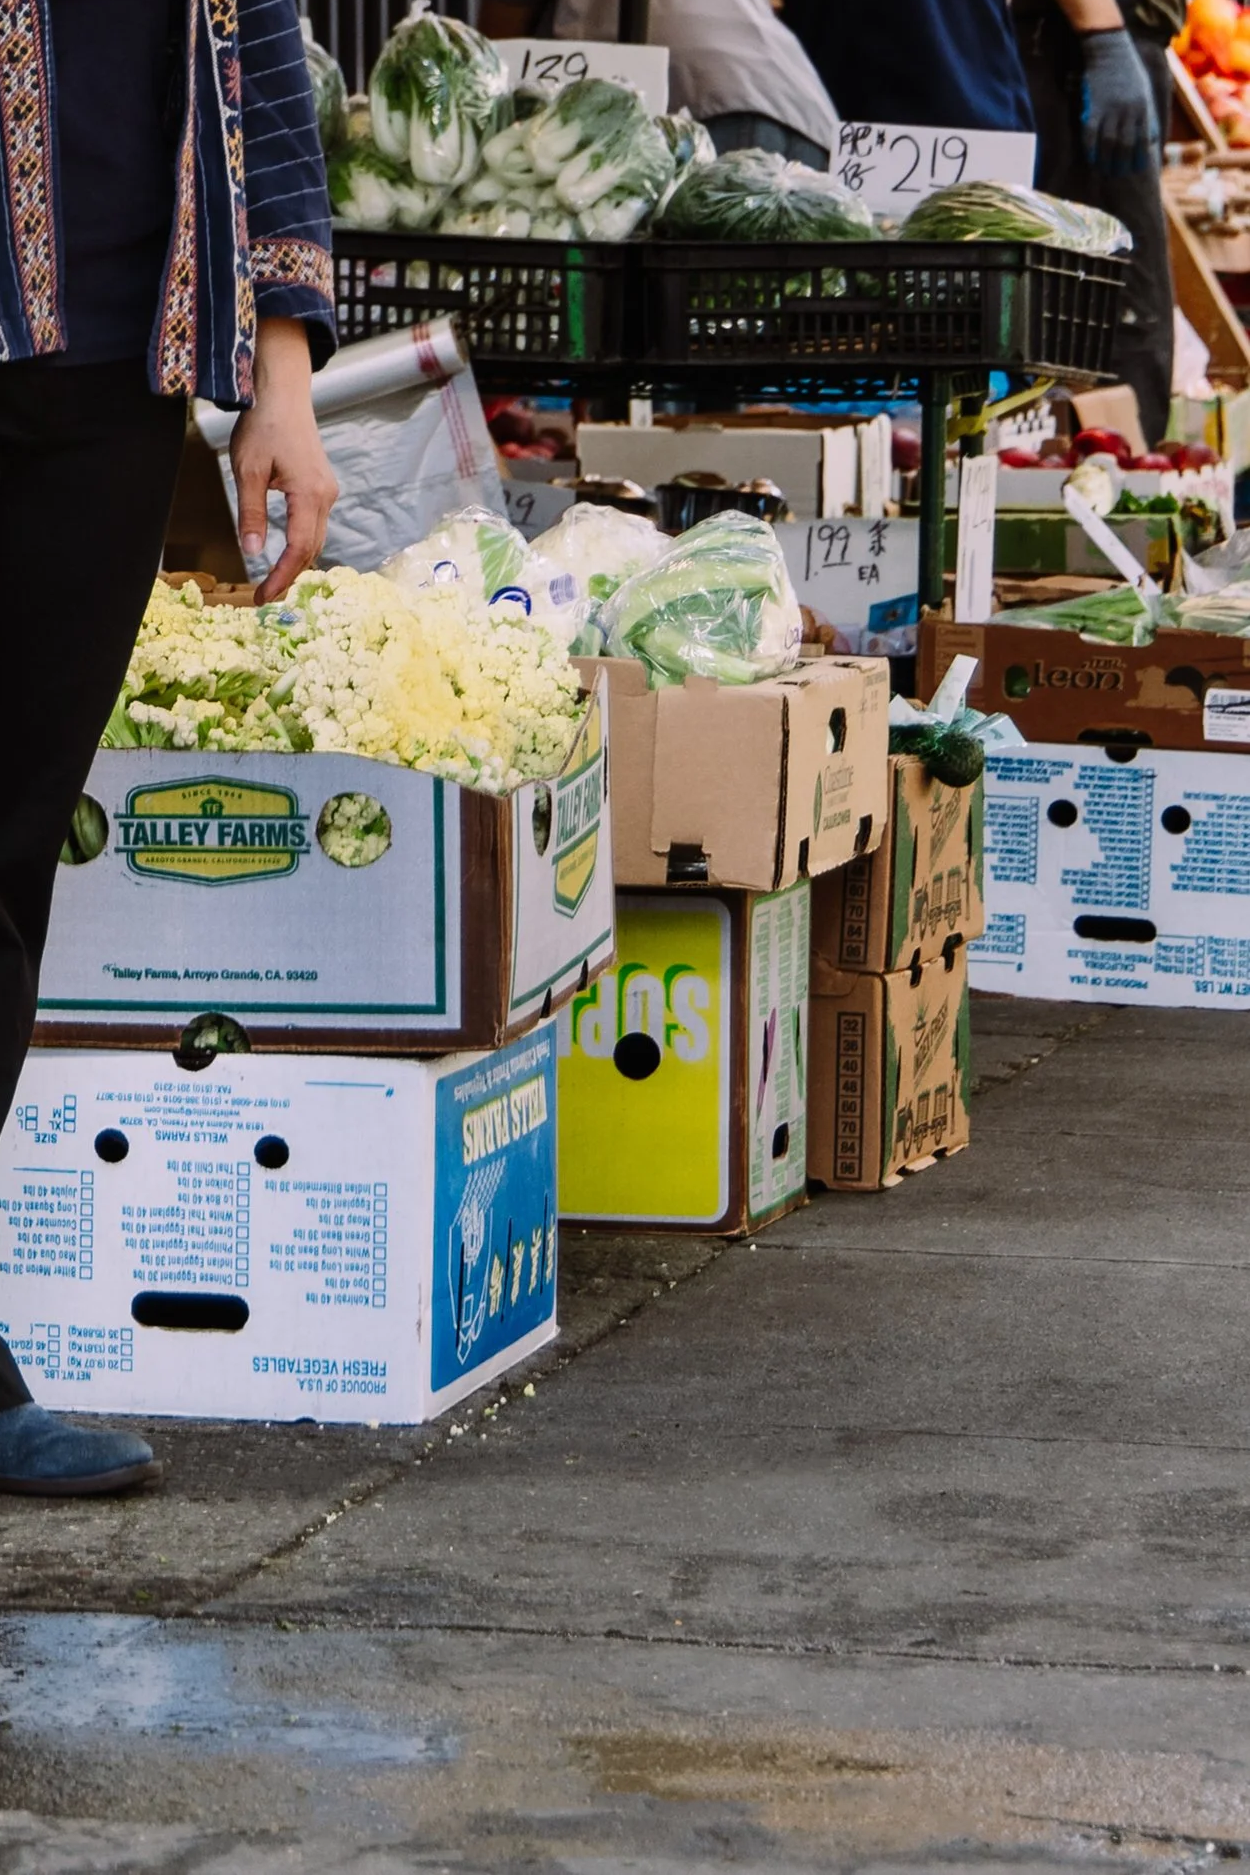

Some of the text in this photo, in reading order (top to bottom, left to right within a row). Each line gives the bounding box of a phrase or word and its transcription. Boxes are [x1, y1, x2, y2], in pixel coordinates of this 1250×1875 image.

[858, 563, 880, 585] EA
[119, 822, 210, 845] TALLEY
[112, 968, 142, 980] Talley
[145, 969, 181, 981] Farms,
[183, 969, 218, 981] Arroyo
[221, 969, 262, 981] Grande,
[286, 971, 318, 980] 93420
[462, 1074, 547, 1165] WELLS FARMS
[35, 1133, 57, 1143] SIZE
[155, 1130, 228, 1143] WELLS FARMS
[23, 1184, 77, 1197] Jujube 40 lbs
[12, 1201, 22, 1212] 40
[25, 1200, 55, 1213] Squash
[57, 1201, 77, 1214] Long
[306, 1198, 370, 1210] Eggplant 40 lbs
[9, 1217, 77, 1230] Cucumber 40 lbs
[319, 1214, 370, 1226] Moap 30 lbs
[18, 1232, 76, 1245] Sin Qua 30 lbs
[293, 1229, 370, 1242] Green Bean 30 lbs
[13, 1248, 76, 1262] Mao Qua 40 lbs
[270, 1244, 370, 1257] White Long Bean 30 lbs
[13, 1265, 23, 1275] 30
[26, 1265, 51, 1276] Melon
[54, 1266, 76, 1277] Bitter
[269, 1260, 369, 1273] Green Long Bean 30 lbs
[325, 1277, 369, 1290] Opo 40 lbs
[306, 1293, 369, 1305] Kohlrabi 40 lbs
[252, 1357, 386, 1376] FRESH VEGETABLES
[296, 1378, 386, 1394] PRODUCE OF U.S.A.
